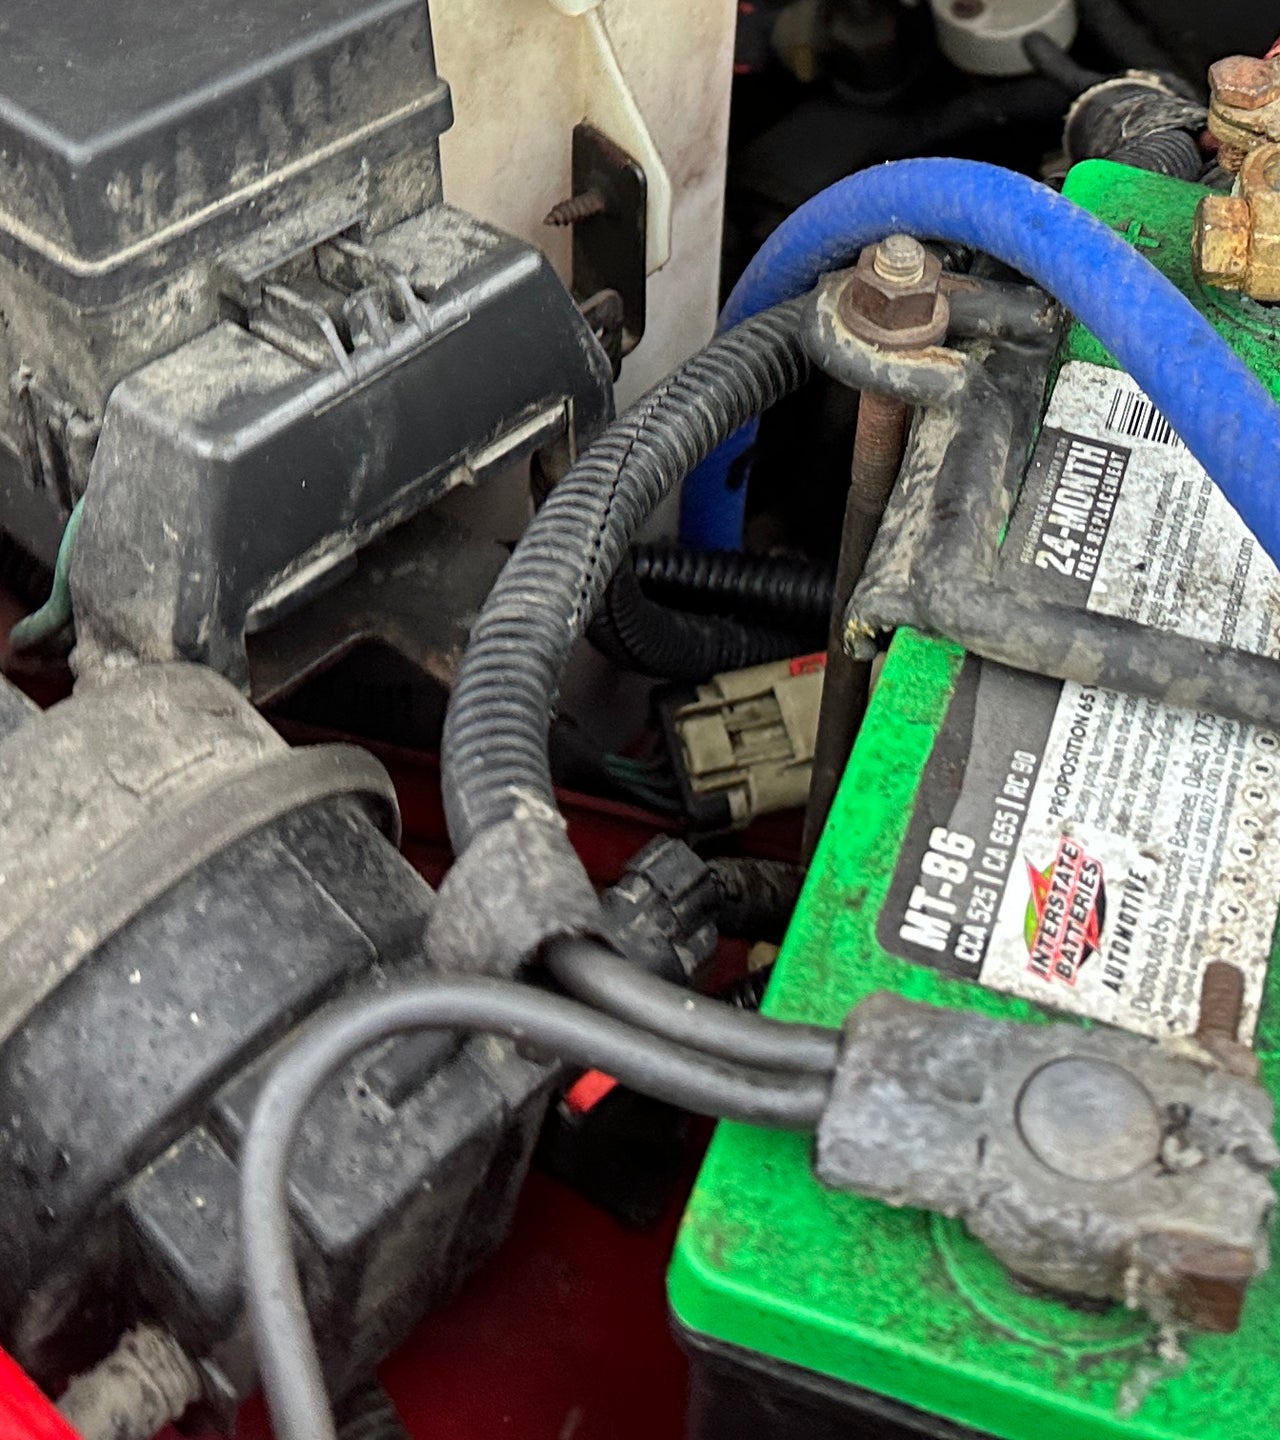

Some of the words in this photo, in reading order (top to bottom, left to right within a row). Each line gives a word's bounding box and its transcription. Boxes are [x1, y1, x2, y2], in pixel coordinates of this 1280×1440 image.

[1033, 439, 1108, 576] 24-MONTH
[1085, 450, 1127, 545] REPLACEMENT
[1074, 545, 1099, 581] FREE
[1215, 536, 1256, 647] terstatebatteries.com
[1010, 749, 1037, 774] 90
[1047, 713, 1090, 817] PROPOSITION
[1076, 691, 1096, 712] 65
[1180, 746, 1210, 789] Dallas,
[1189, 729, 1212, 748] TX
[1002, 773, 1031, 799] RC
[988, 809, 1021, 847] 655
[1167, 788, 1200, 848] Batteries,
[897, 824, 977, 951] MT-86
[981, 844, 1010, 872] CA
[1149, 847, 1185, 912] Interstate
[965, 884, 999, 924] 525
[1028, 842, 1080, 975] INTERSTATE
[1053, 856, 1101, 979] BATTERIES
[1100, 867, 1148, 994] AUTOMOTIVE
[1147, 913, 1177, 934] by
[953, 922, 987, 963] CCA
[1128, 930, 1167, 1012] Distributed
